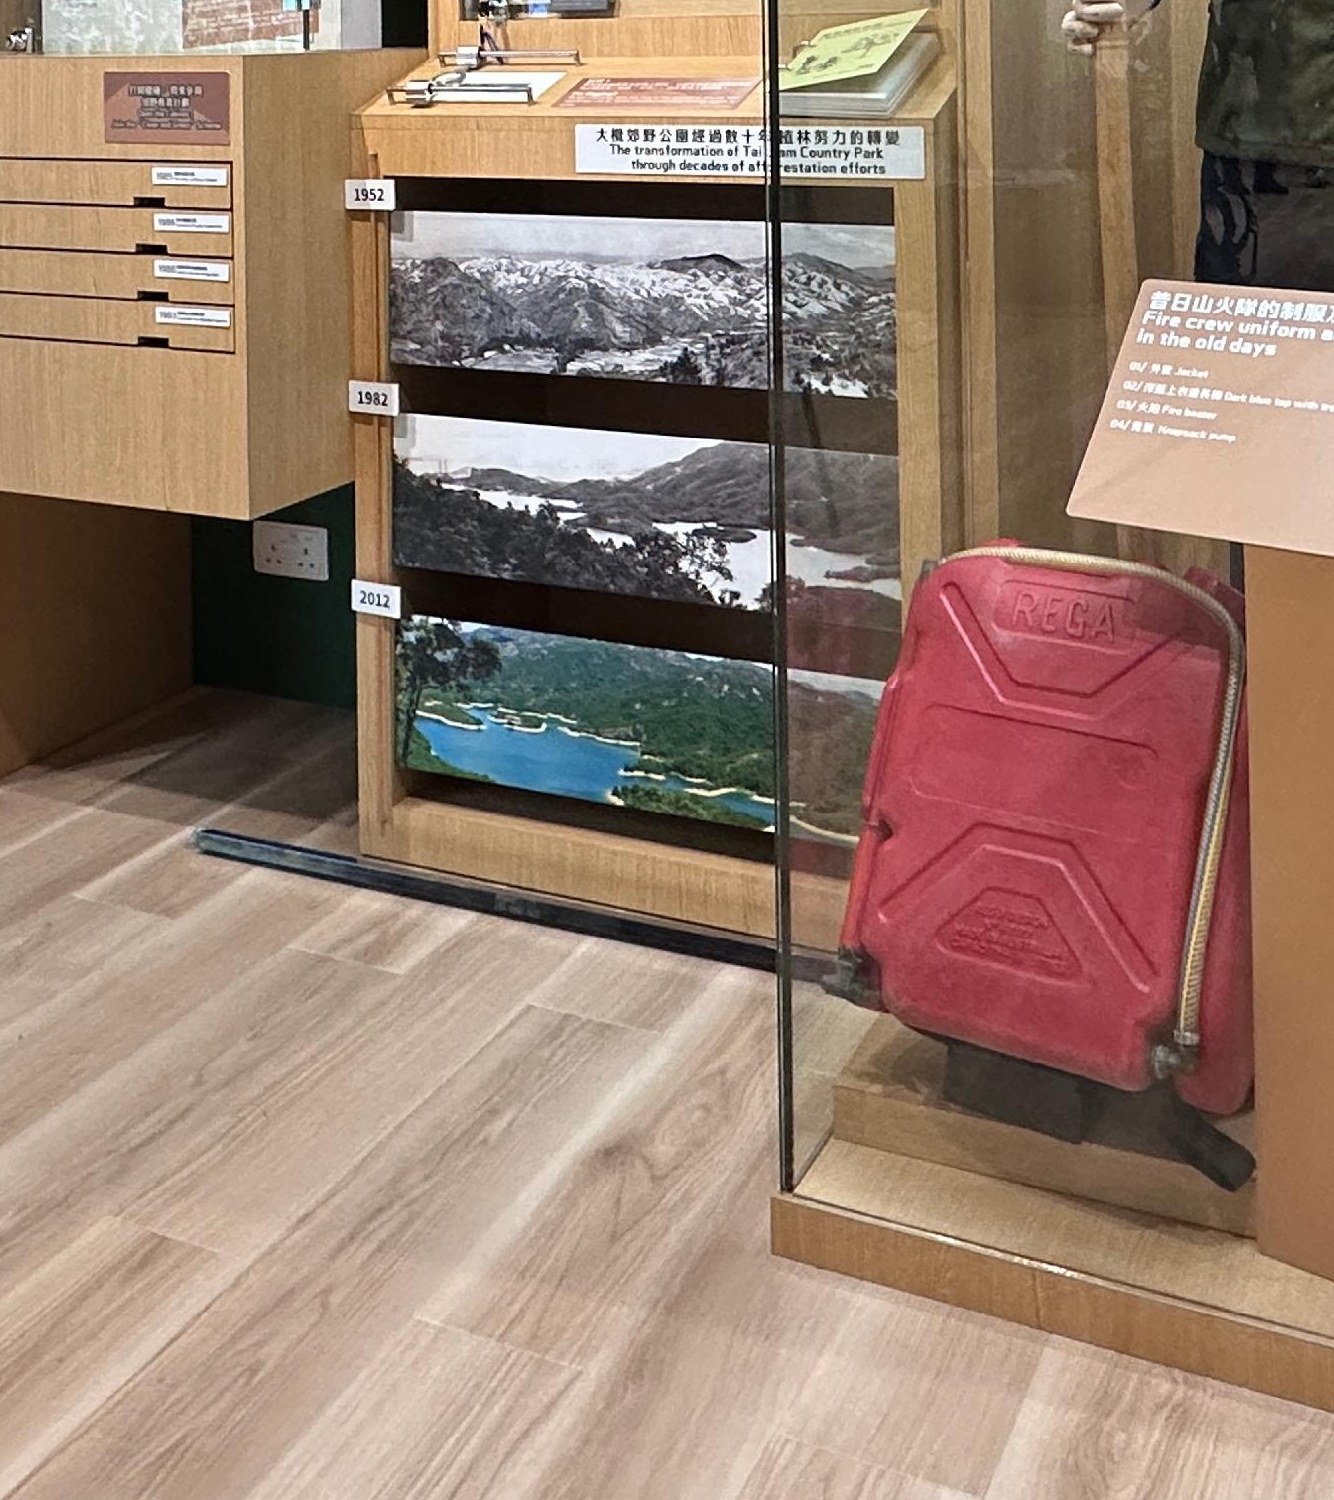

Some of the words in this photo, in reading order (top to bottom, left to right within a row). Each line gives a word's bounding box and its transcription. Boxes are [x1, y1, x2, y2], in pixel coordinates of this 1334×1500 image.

[609, 144, 630, 154] The
[635, 145, 723, 155] transformation
[727, 146, 737, 156] of
[743, 146, 761, 156] Tai
[800, 146, 850, 160] Country
[854, 147, 883, 162] Park
[631, 159, 675, 174] through
[679, 160, 728, 175] decades
[731, 160, 743, 175] of
[841, 162, 885, 173] efforts
[355, 188, 383, 201] 1952
[1140, 311, 1181, 333] Fire
[1185, 317, 1233, 337] crew
[1238, 321, 1315, 340] uniform
[1136, 331, 1154, 343] in
[1160, 333, 1190, 347] the
[1195, 336, 1226, 352] old
[1229, 339, 1277, 357] days
[358, 391, 387, 406] 1982
[360, 592, 389, 608] 2012
[1012, 590, 1116, 643] REGA
